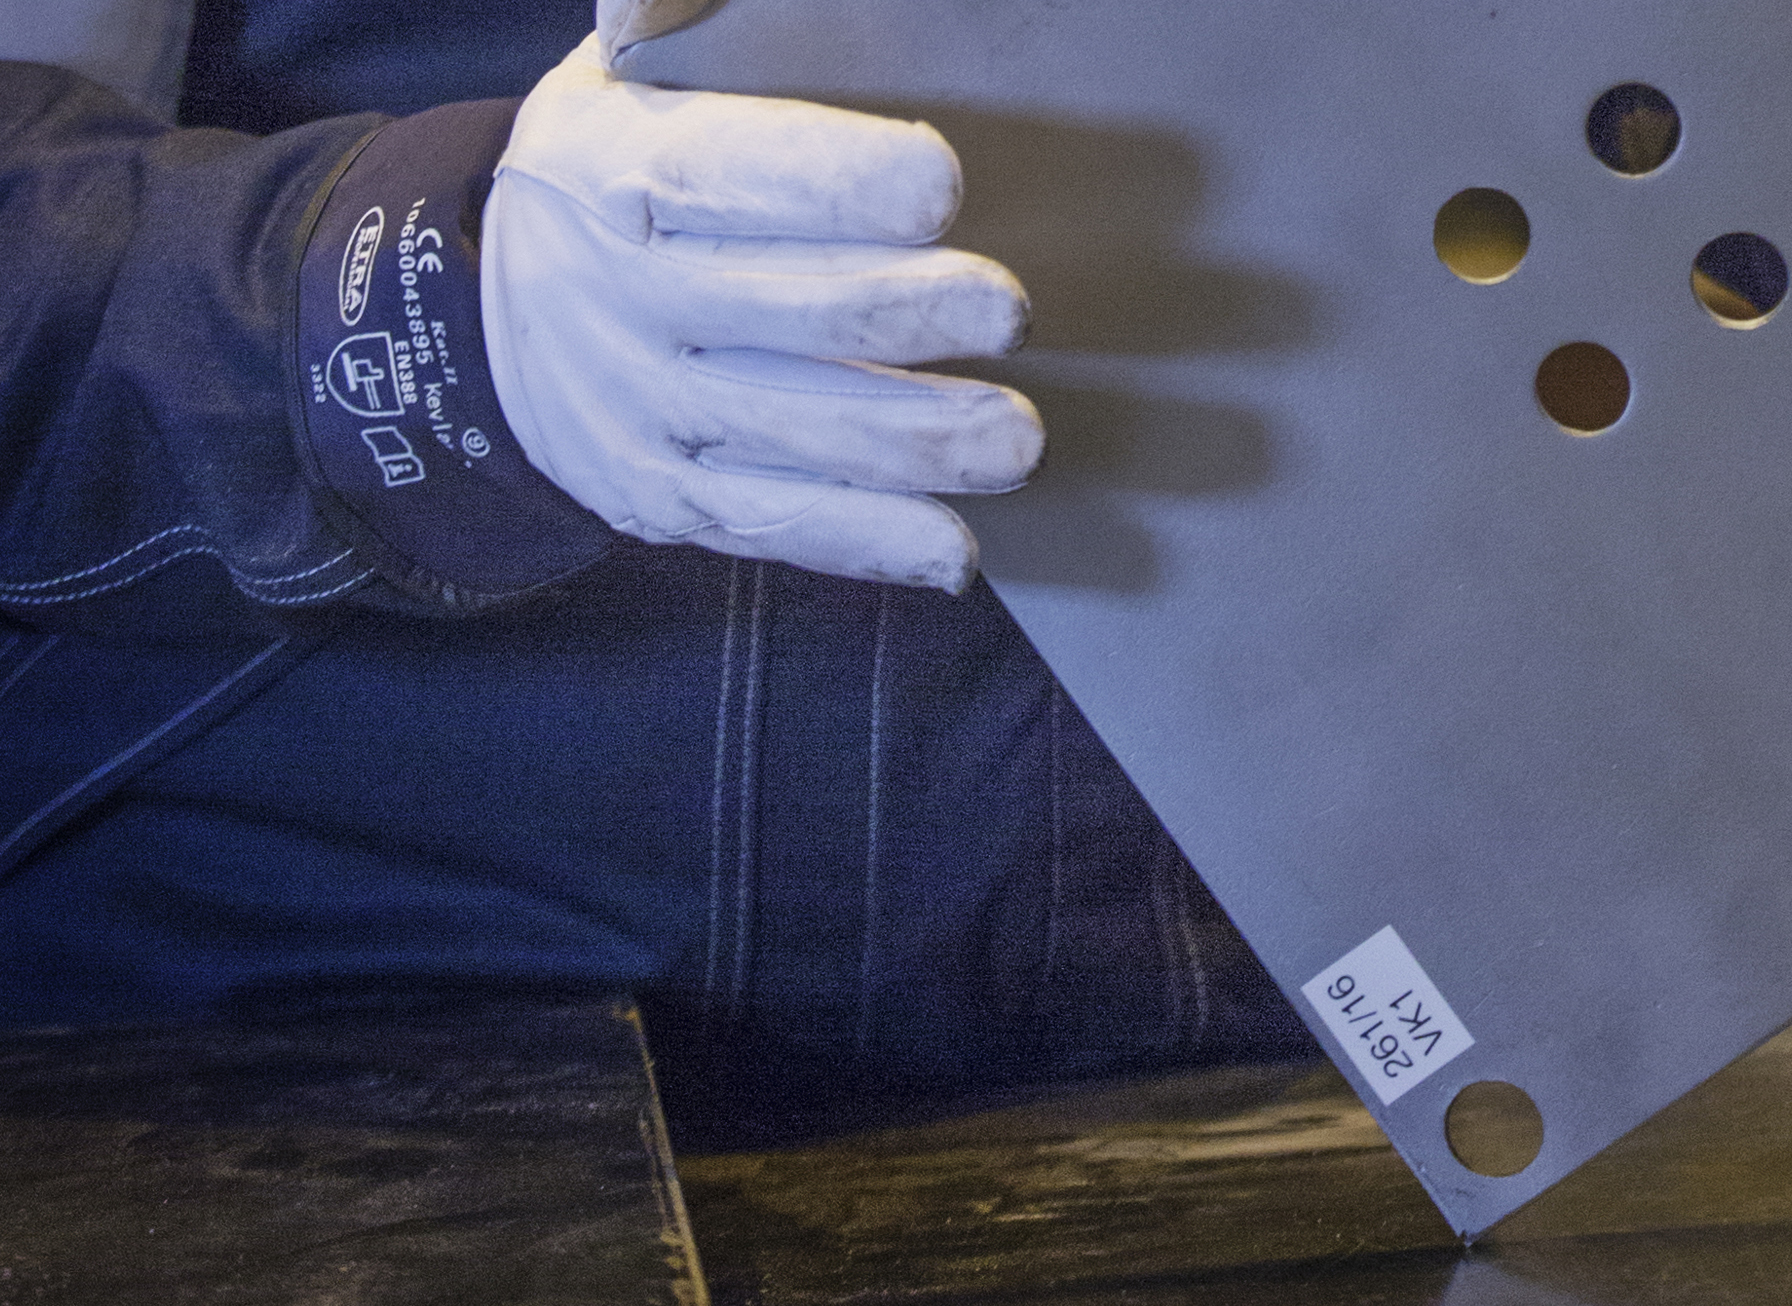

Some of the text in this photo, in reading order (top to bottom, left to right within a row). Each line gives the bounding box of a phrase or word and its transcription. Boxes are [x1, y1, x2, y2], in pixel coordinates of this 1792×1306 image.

[348, 225, 379, 312] ETRA
[398, 197, 434, 365] 10660043895
[310, 363, 326, 403] 3322
[1327, 975, 1414, 1078] 261/16
[1389, 989, 1443, 1056] VK1
